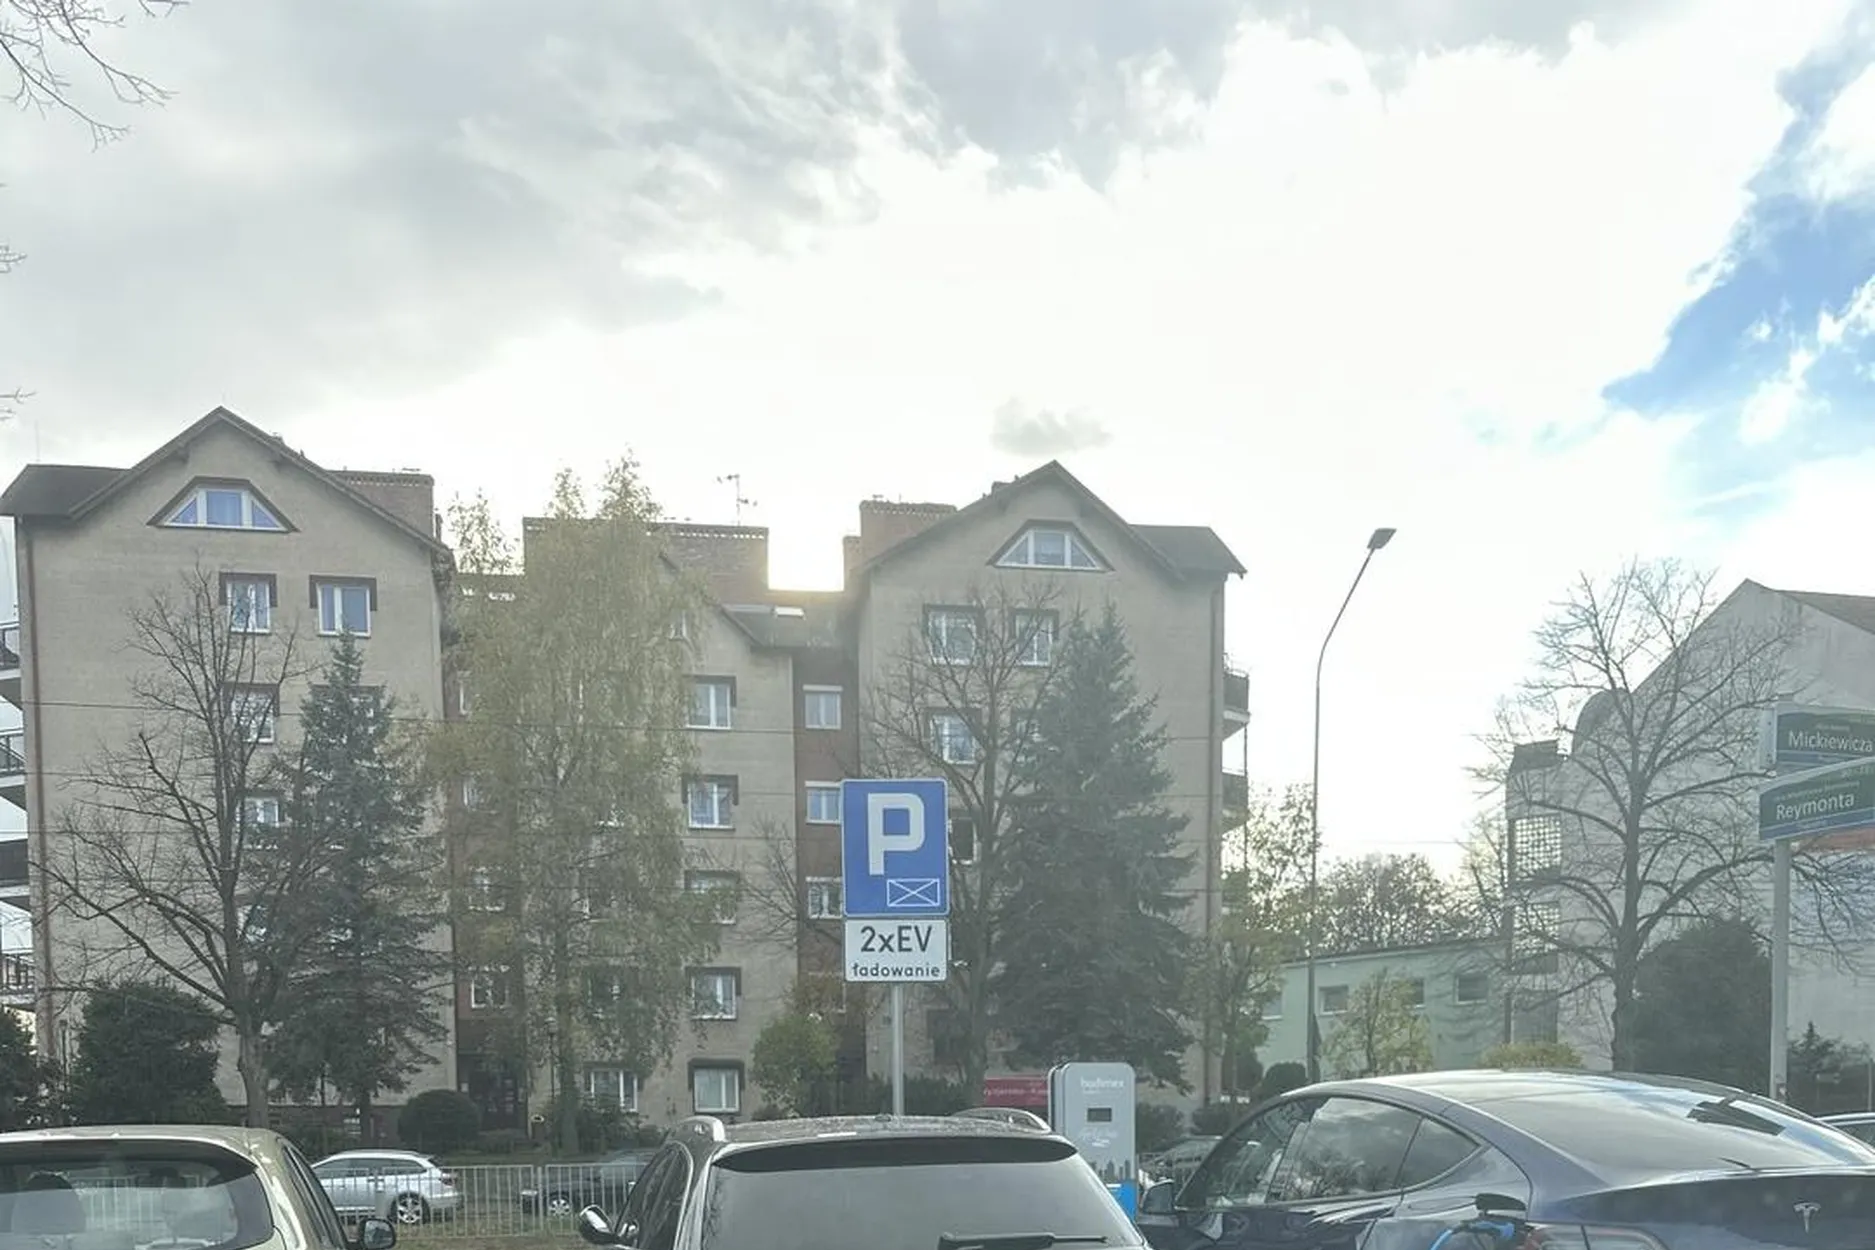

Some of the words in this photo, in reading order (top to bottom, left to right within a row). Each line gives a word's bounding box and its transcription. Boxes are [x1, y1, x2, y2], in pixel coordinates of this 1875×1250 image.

[1788, 730, 1873, 752] Mickiewicza
[1775, 793, 1854, 820] Reymonta
[867, 793, 925, 875] P
[860, 925, 932, 953] 2xEV
